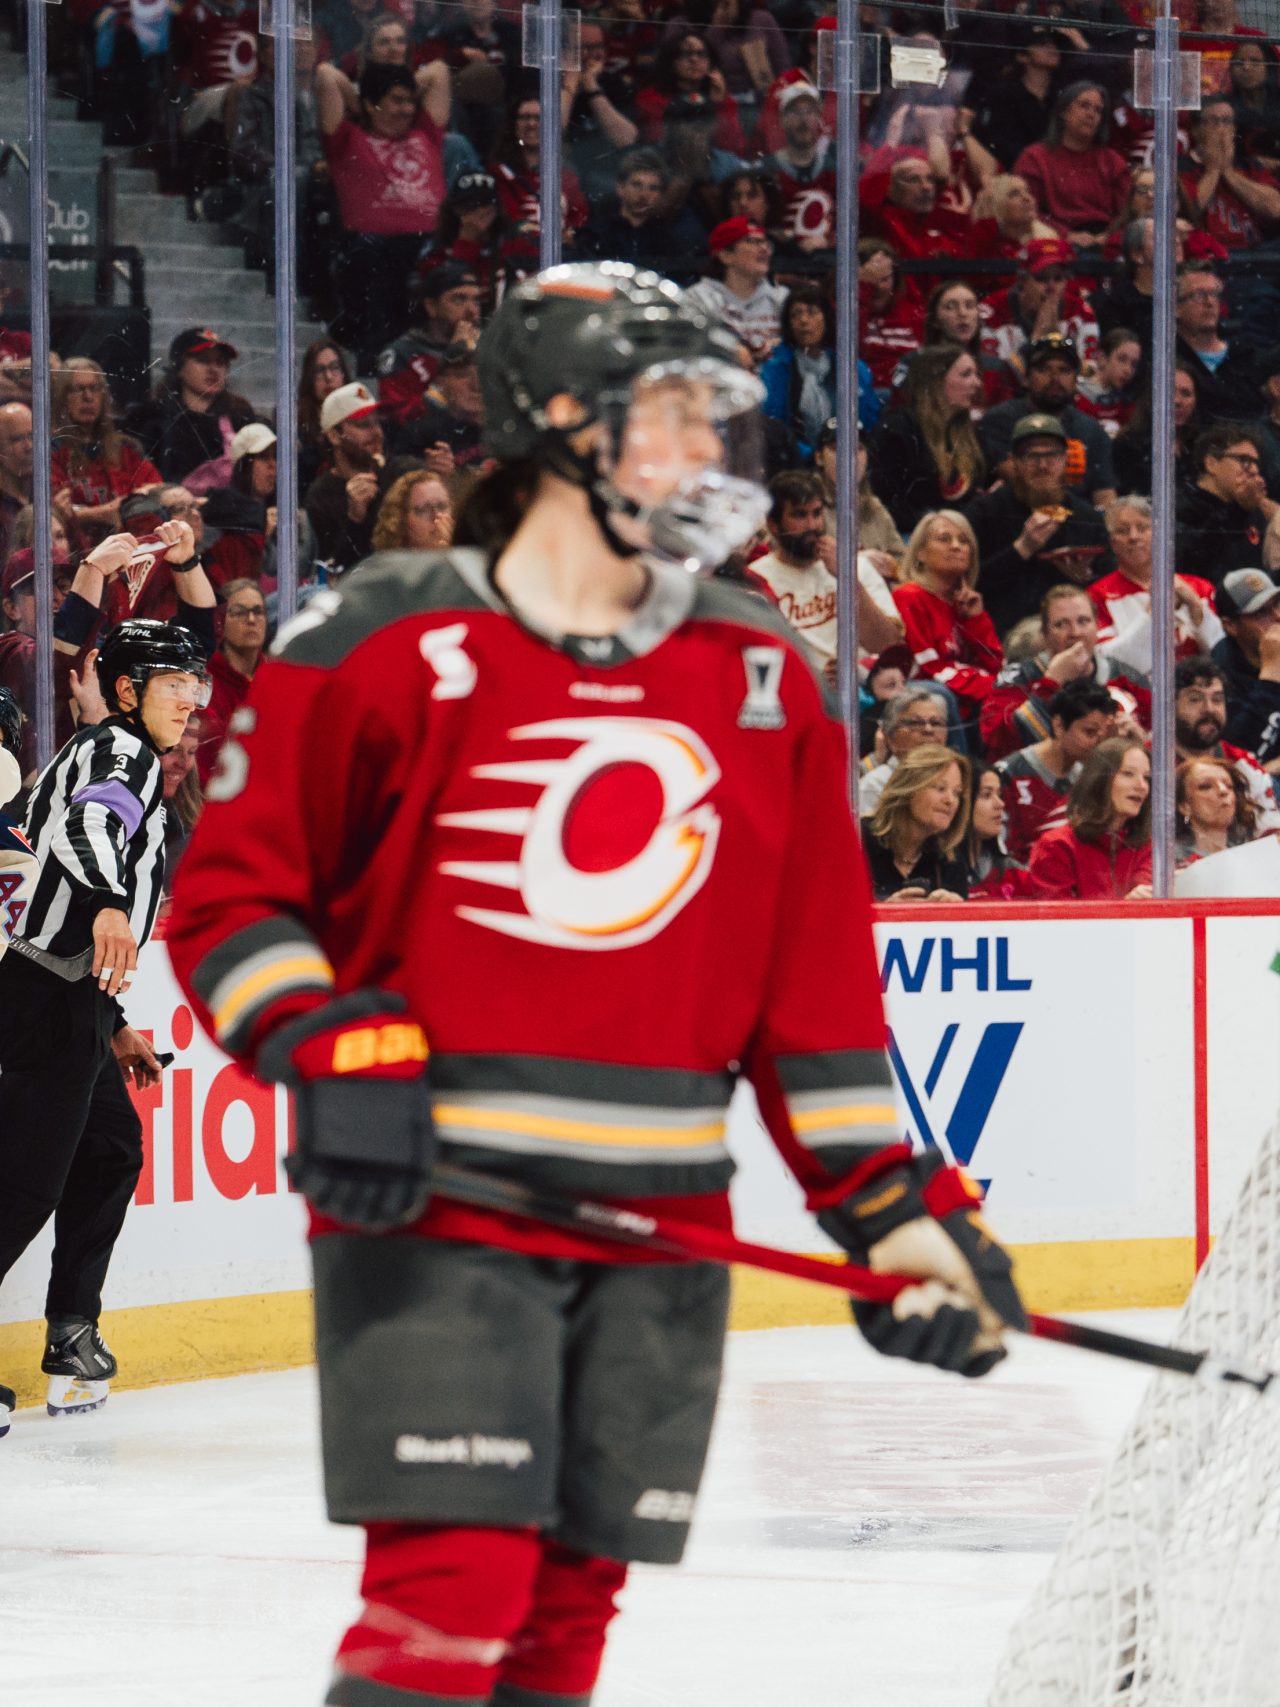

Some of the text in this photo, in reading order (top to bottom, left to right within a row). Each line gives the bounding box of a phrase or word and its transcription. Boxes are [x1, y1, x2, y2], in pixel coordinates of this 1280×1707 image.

[120, 627, 152, 638] PWHL
[114, 755, 128, 769] 3
[880, 936, 1033, 994] WHL
